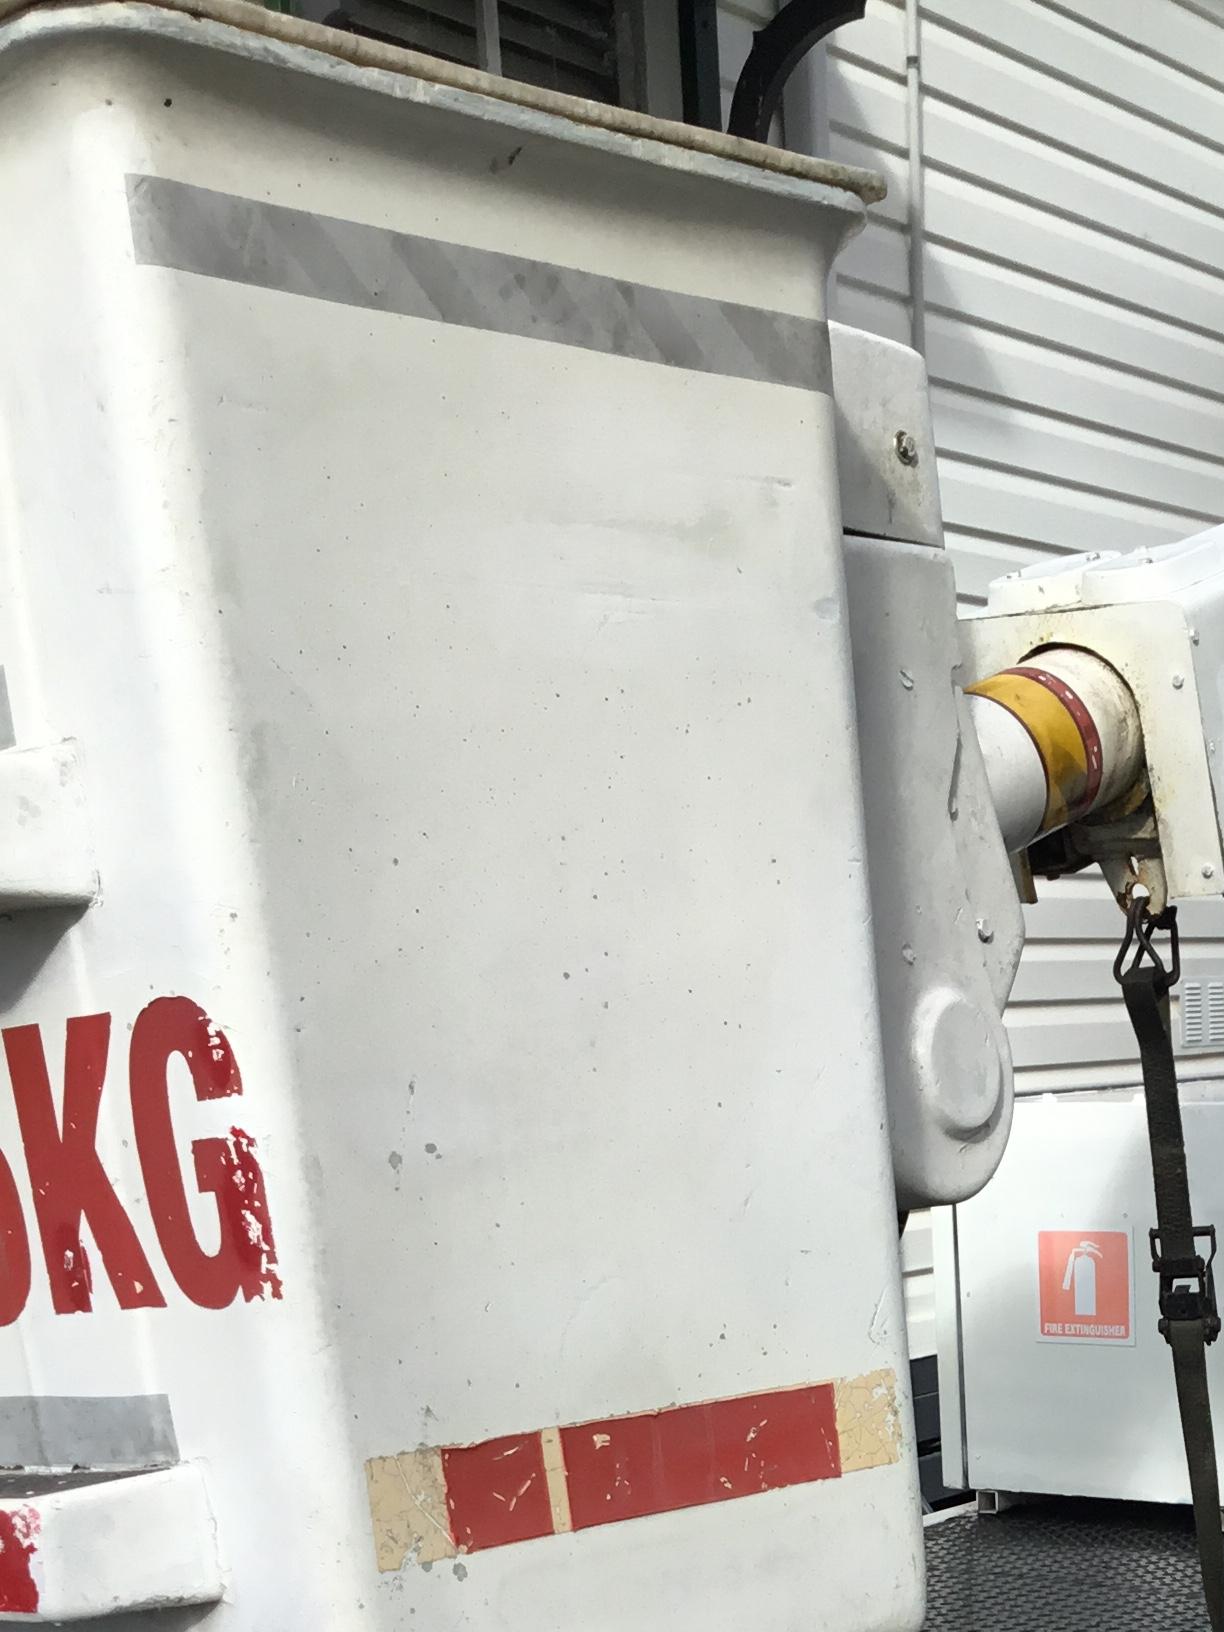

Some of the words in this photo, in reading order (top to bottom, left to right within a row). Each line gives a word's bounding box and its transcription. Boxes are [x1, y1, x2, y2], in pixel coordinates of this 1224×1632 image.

[0, 996, 283, 1327] KG
[1044, 1322, 1063, 1334] FIRE
[1064, 1323, 1126, 1336] EXTINGUISHER
